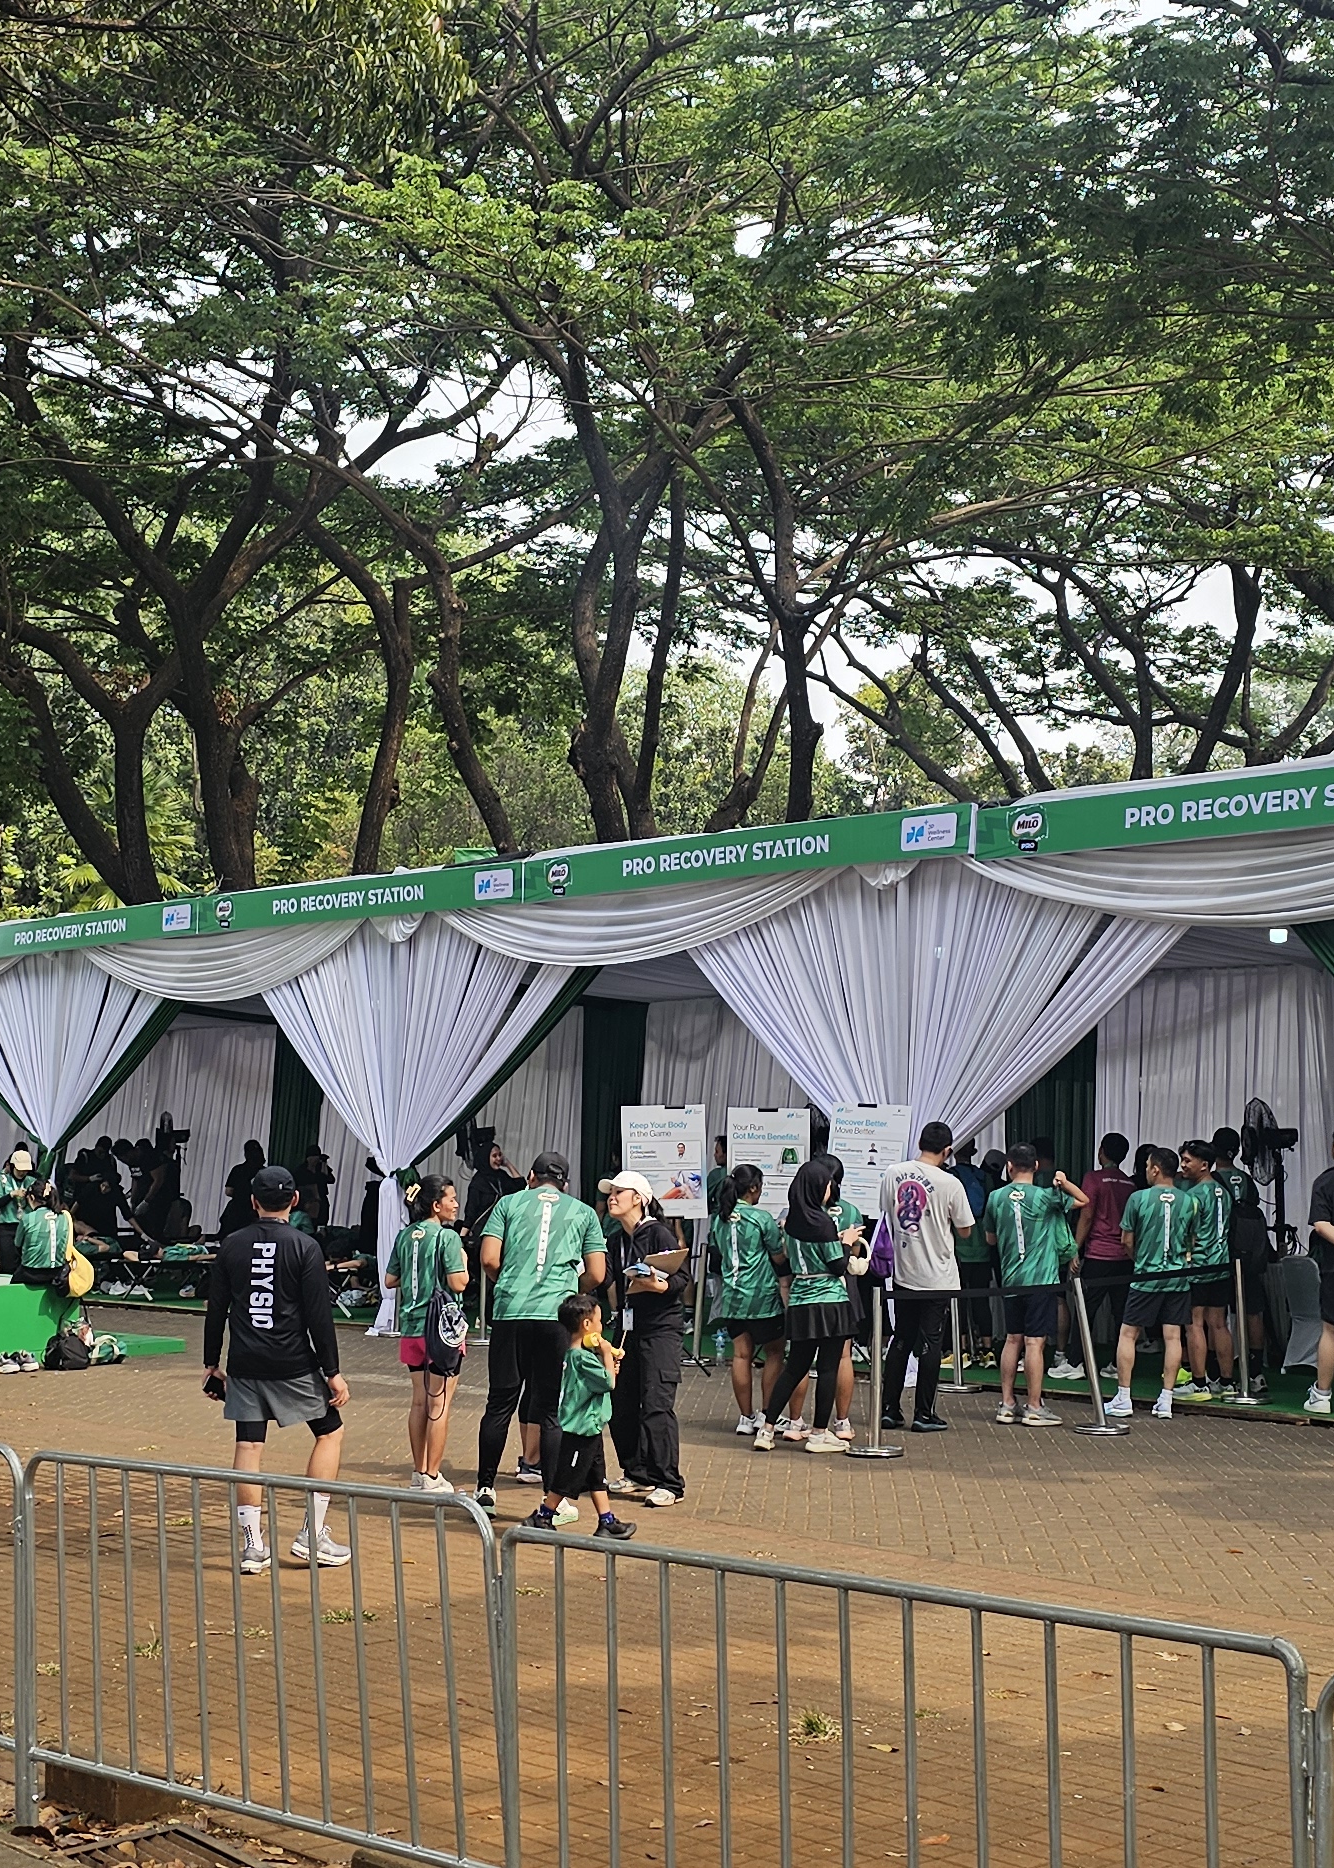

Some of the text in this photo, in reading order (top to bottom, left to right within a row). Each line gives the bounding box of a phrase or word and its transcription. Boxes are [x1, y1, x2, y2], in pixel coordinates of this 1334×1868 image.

[1125, 803, 1175, 829] PRO
[1181, 786, 1318, 823] RECOVERY
[1017, 818, 1039, 831] MILO
[622, 834, 829, 877] PRO RECOVERY STATION
[272, 884, 424, 915] PRO RECOVERY STATION
[14, 918, 126, 946] PRO RECOVERY STATION
[629, 1121, 687, 1130] Keep Your Body
[733, 1123, 748, 1131] Your
[835, 1118, 888, 1128] Recover Better.
[649, 1130, 672, 1138] Game
[835, 1126, 853, 1134] Move
[733, 1132, 746, 1140] Got
